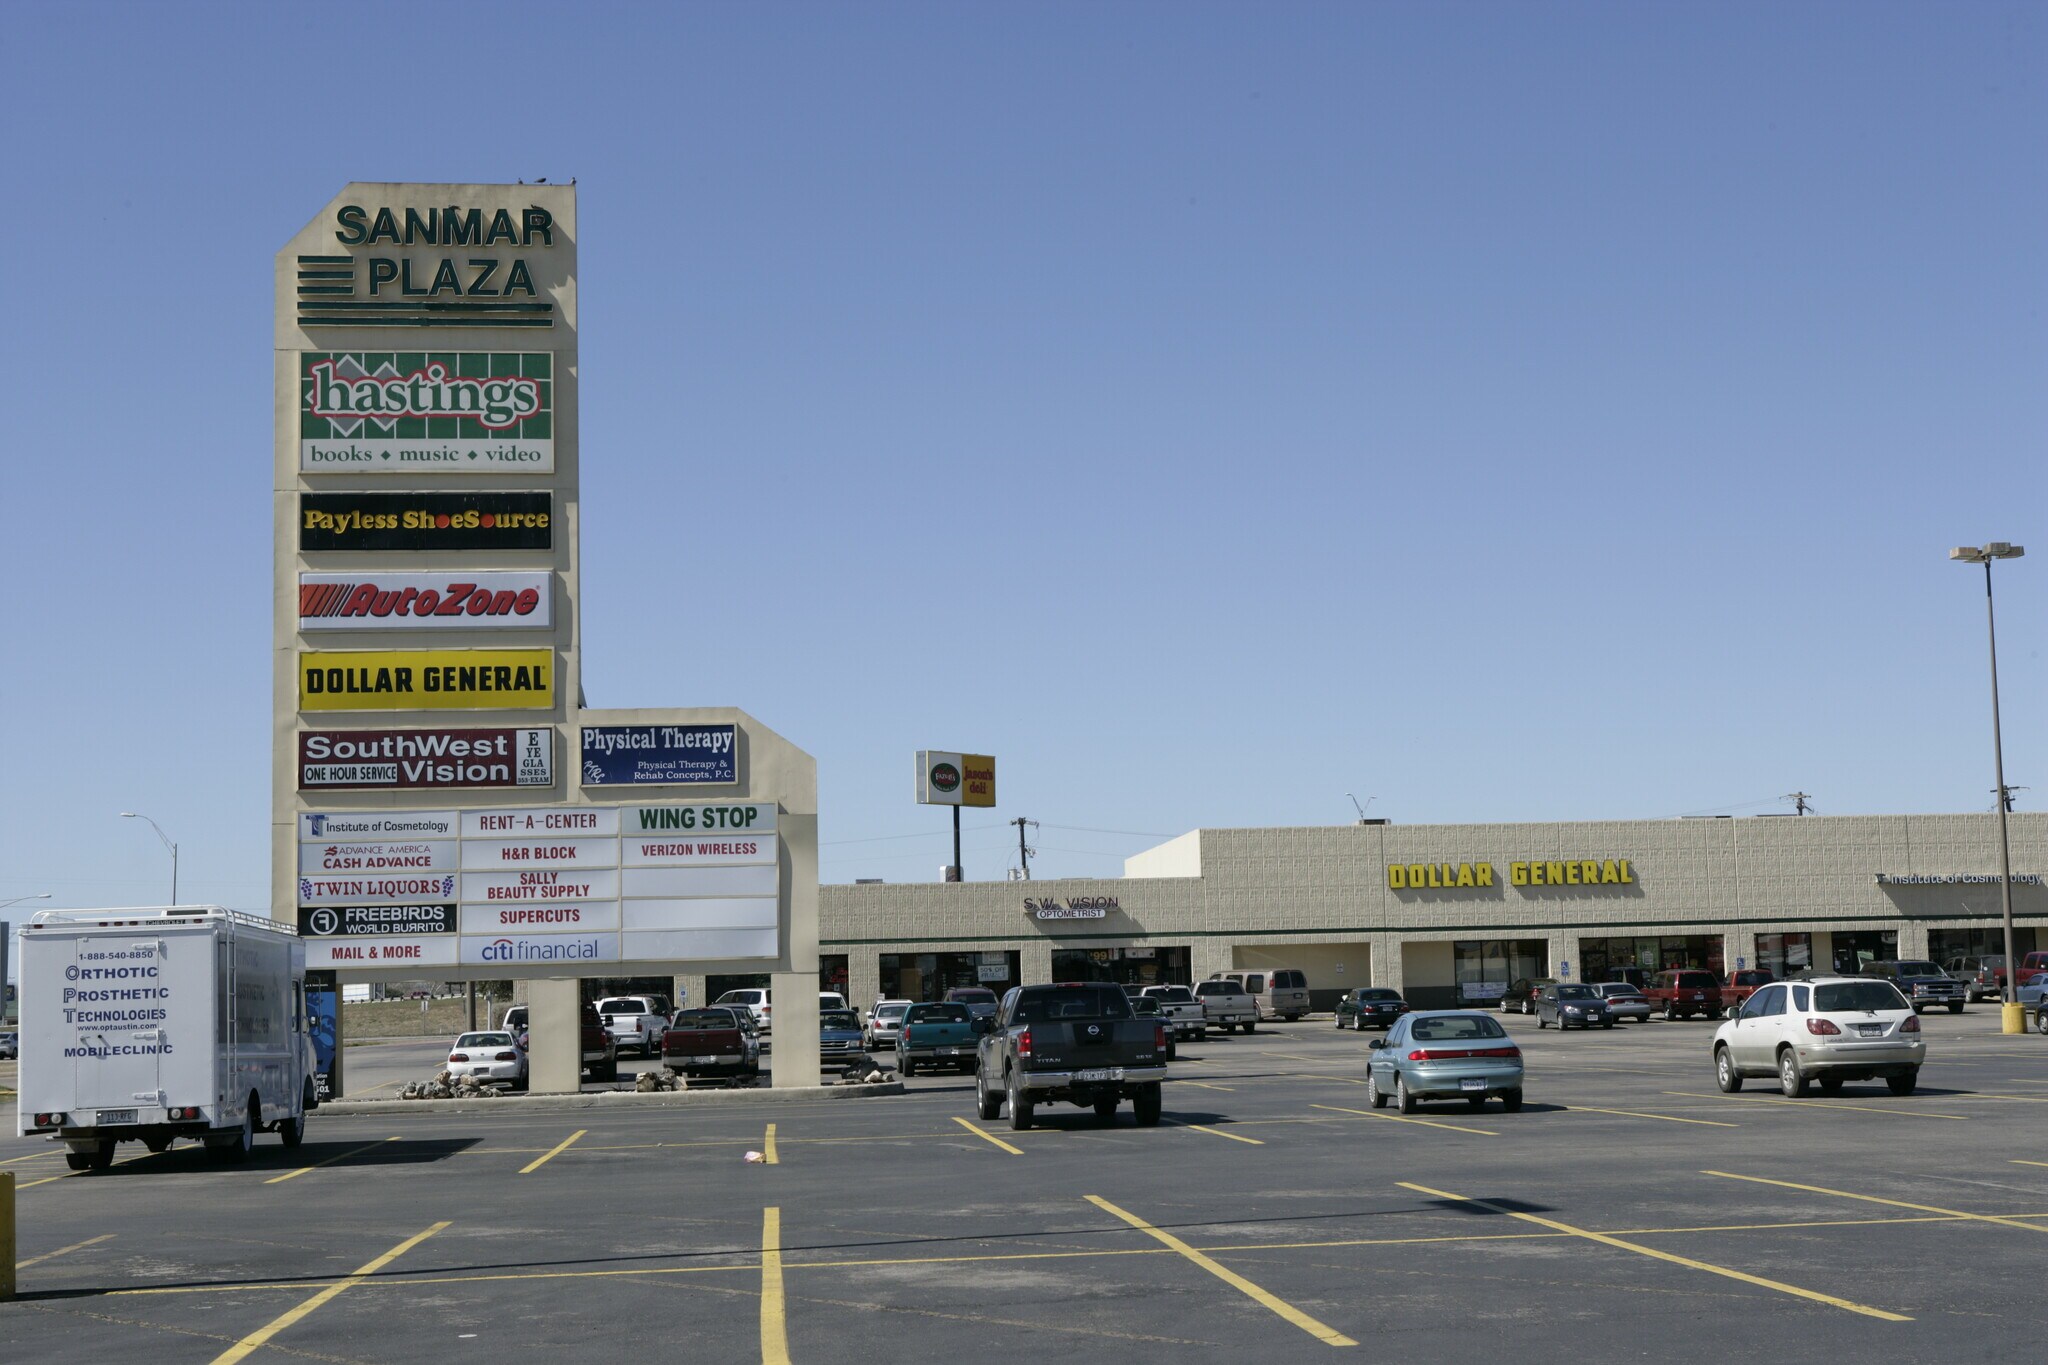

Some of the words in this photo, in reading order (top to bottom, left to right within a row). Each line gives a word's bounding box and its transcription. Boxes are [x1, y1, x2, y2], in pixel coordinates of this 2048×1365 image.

[335, 205, 553, 247] SANMAR
[369, 258, 538, 297] PLAZA
[311, 362, 539, 427] hastings
[310, 445, 373, 463] books
[399, 445, 459, 462] music
[485, 445, 541, 462] video
[304, 509, 398, 534] Payless
[340, 583, 540, 617] AutoZone
[306, 667, 414, 694] DOLLAR
[423, 665, 546, 692] GENERAL
[528, 732, 538, 746] E
[583, 727, 656, 755] Physical
[661, 727, 733, 754] Therapy
[306, 735, 508, 759] SouthWest
[526, 747, 541, 758] YE
[401, 760, 510, 782] Vision
[522, 759, 544, 768] GLA
[638, 761, 676, 771] Physical
[678, 760, 717, 770] Therapy
[305, 767, 326, 780] ONE
[330, 767, 357, 780] HOUR
[360, 766, 396, 780] SERVICE
[634, 771, 664, 780] Rehab
[666, 770, 713, 780] Concepts,
[970, 781, 986, 794] deli
[480, 813, 597, 830] RENT-A-CENTER
[639, 808, 696, 829] WING
[702, 807, 758, 828] STOP
[326, 822, 369, 833] Institute
[371, 821, 382, 832] of
[384, 821, 449, 833] Cosmetology
[339, 846, 383, 855] ADVANCE
[388, 845, 431, 854] AMERICA
[502, 848, 530, 860] H&R
[534, 846, 576, 859] BLOCK
[642, 843, 693, 856] VERIZON
[697, 842, 757, 855] WIRELESS
[323, 858, 361, 869] CASH
[366, 856, 431, 868] ADVANCE
[520, 872, 558, 885] SALLY
[1388, 862, 1493, 889] DOLLAR
[1509, 858, 1633, 886] GENERAL
[1891, 873, 1944, 884] Institute
[1947, 873, 1959, 884] of
[1962, 872, 2041, 885] Cosmeology
[314, 881, 363, 896] TWIN
[367, 879, 440, 898] LIQUORS
[488, 886, 536, 899] BEAUTY
[541, 884, 590, 898] SUPPLY
[1066, 896, 1119, 909] VISION
[500, 909, 580, 924] SUPERCUTS
[1040, 909, 1101, 918] OPTOMETRIST
[79, 951, 153, 960] 1-888-540-8850
[332, 947, 364, 960] MAIL
[369, 946, 378, 959] &
[383, 945, 421, 958] MORE
[482, 939, 513, 960] citi
[517, 939, 598, 960] financial
[65, 965, 158, 981] ORTHOTIC
[63, 988, 169, 1003] PROSTHETIC
[63, 1008, 166, 1023] TECHNOLOGIES
[77, 1023, 157, 1032] www.optaustin.com
